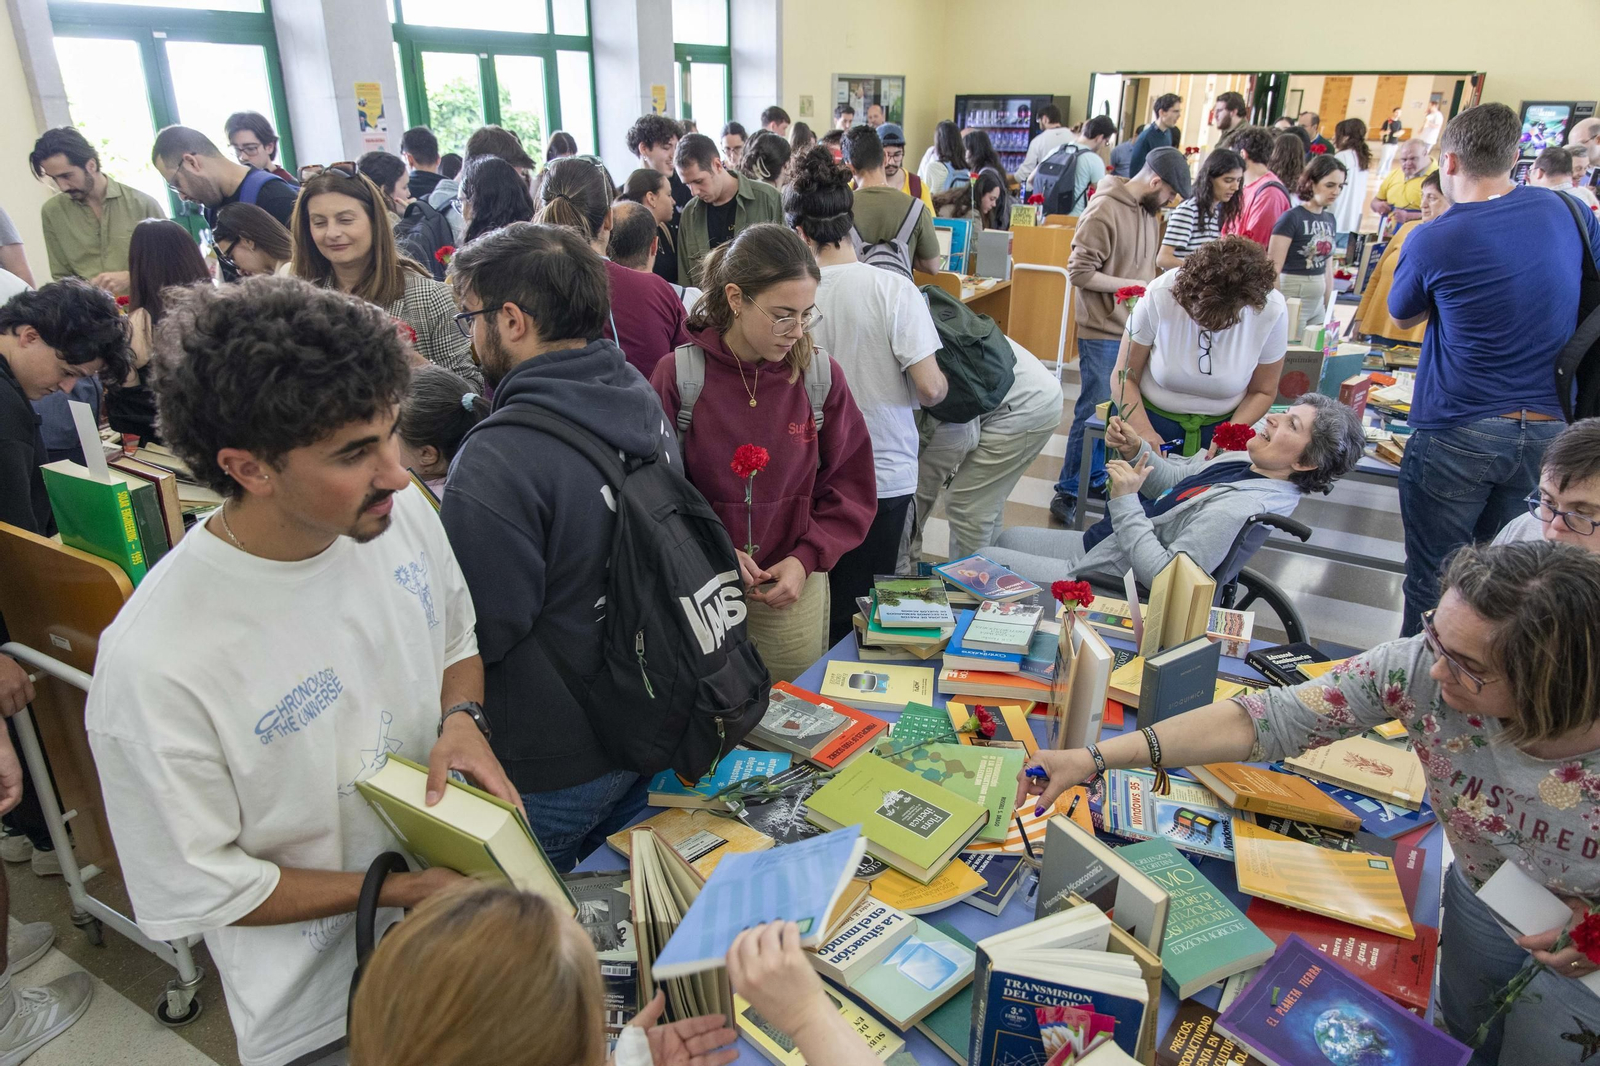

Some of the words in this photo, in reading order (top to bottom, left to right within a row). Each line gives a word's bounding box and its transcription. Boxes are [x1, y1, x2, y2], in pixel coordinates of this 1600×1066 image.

[117, 491, 130, 508] SOLAR
[121, 508, 137, 542] ENGINEERING
[679, 570, 748, 656] VANS
[961, 650, 1007, 659] Contributions
[254, 667, 335, 735] CHRONOLOGY
[260, 731, 274, 745] OF
[271, 717, 300, 738] THE
[299, 675, 344, 727] UNIVERSE
[855, 723, 877, 741] PRINCIPLES
[826, 746, 846, 762] SCIENCE
[841, 739, 856, 751] FOOD
[1146, 726, 1161, 764] ACIONAL
[1130, 780, 1141, 791] 95
[909, 807, 935, 827] iberica
[1131, 792, 1143, 828] Windows
[1449, 770, 1599, 860] INSPIRED
[920, 814, 943, 830] Flora
[1066, 863, 1104, 892] Microeconomics
[872, 907, 886, 920] en
[883, 914, 904, 927] La
[1162, 925, 1184, 941] CASI
[1183, 907, 1234, 932] APPLICATIVI
[817, 926, 861, 956] mundo
[829, 924, 885, 964] situación
[1170, 933, 1209, 956] EDIZIONI
[1208, 921, 1247, 940] AGRICOLE
[1318, 944, 1328, 952] La
[1332, 938, 1342, 957] nueva
[1368, 948, 1380, 970] Común
[1003, 987, 1029, 1000] DEL
[1004, 978, 1093, 1003] TRANSMISION
[1266, 1014, 1279, 1028] EL
[1276, 987, 1303, 1018] PLANETA
[1298, 964, 1323, 988] TIERRA
[1169, 1020, 1196, 1054] PRECIOS,
[1207, 1034, 1220, 1048] EN
